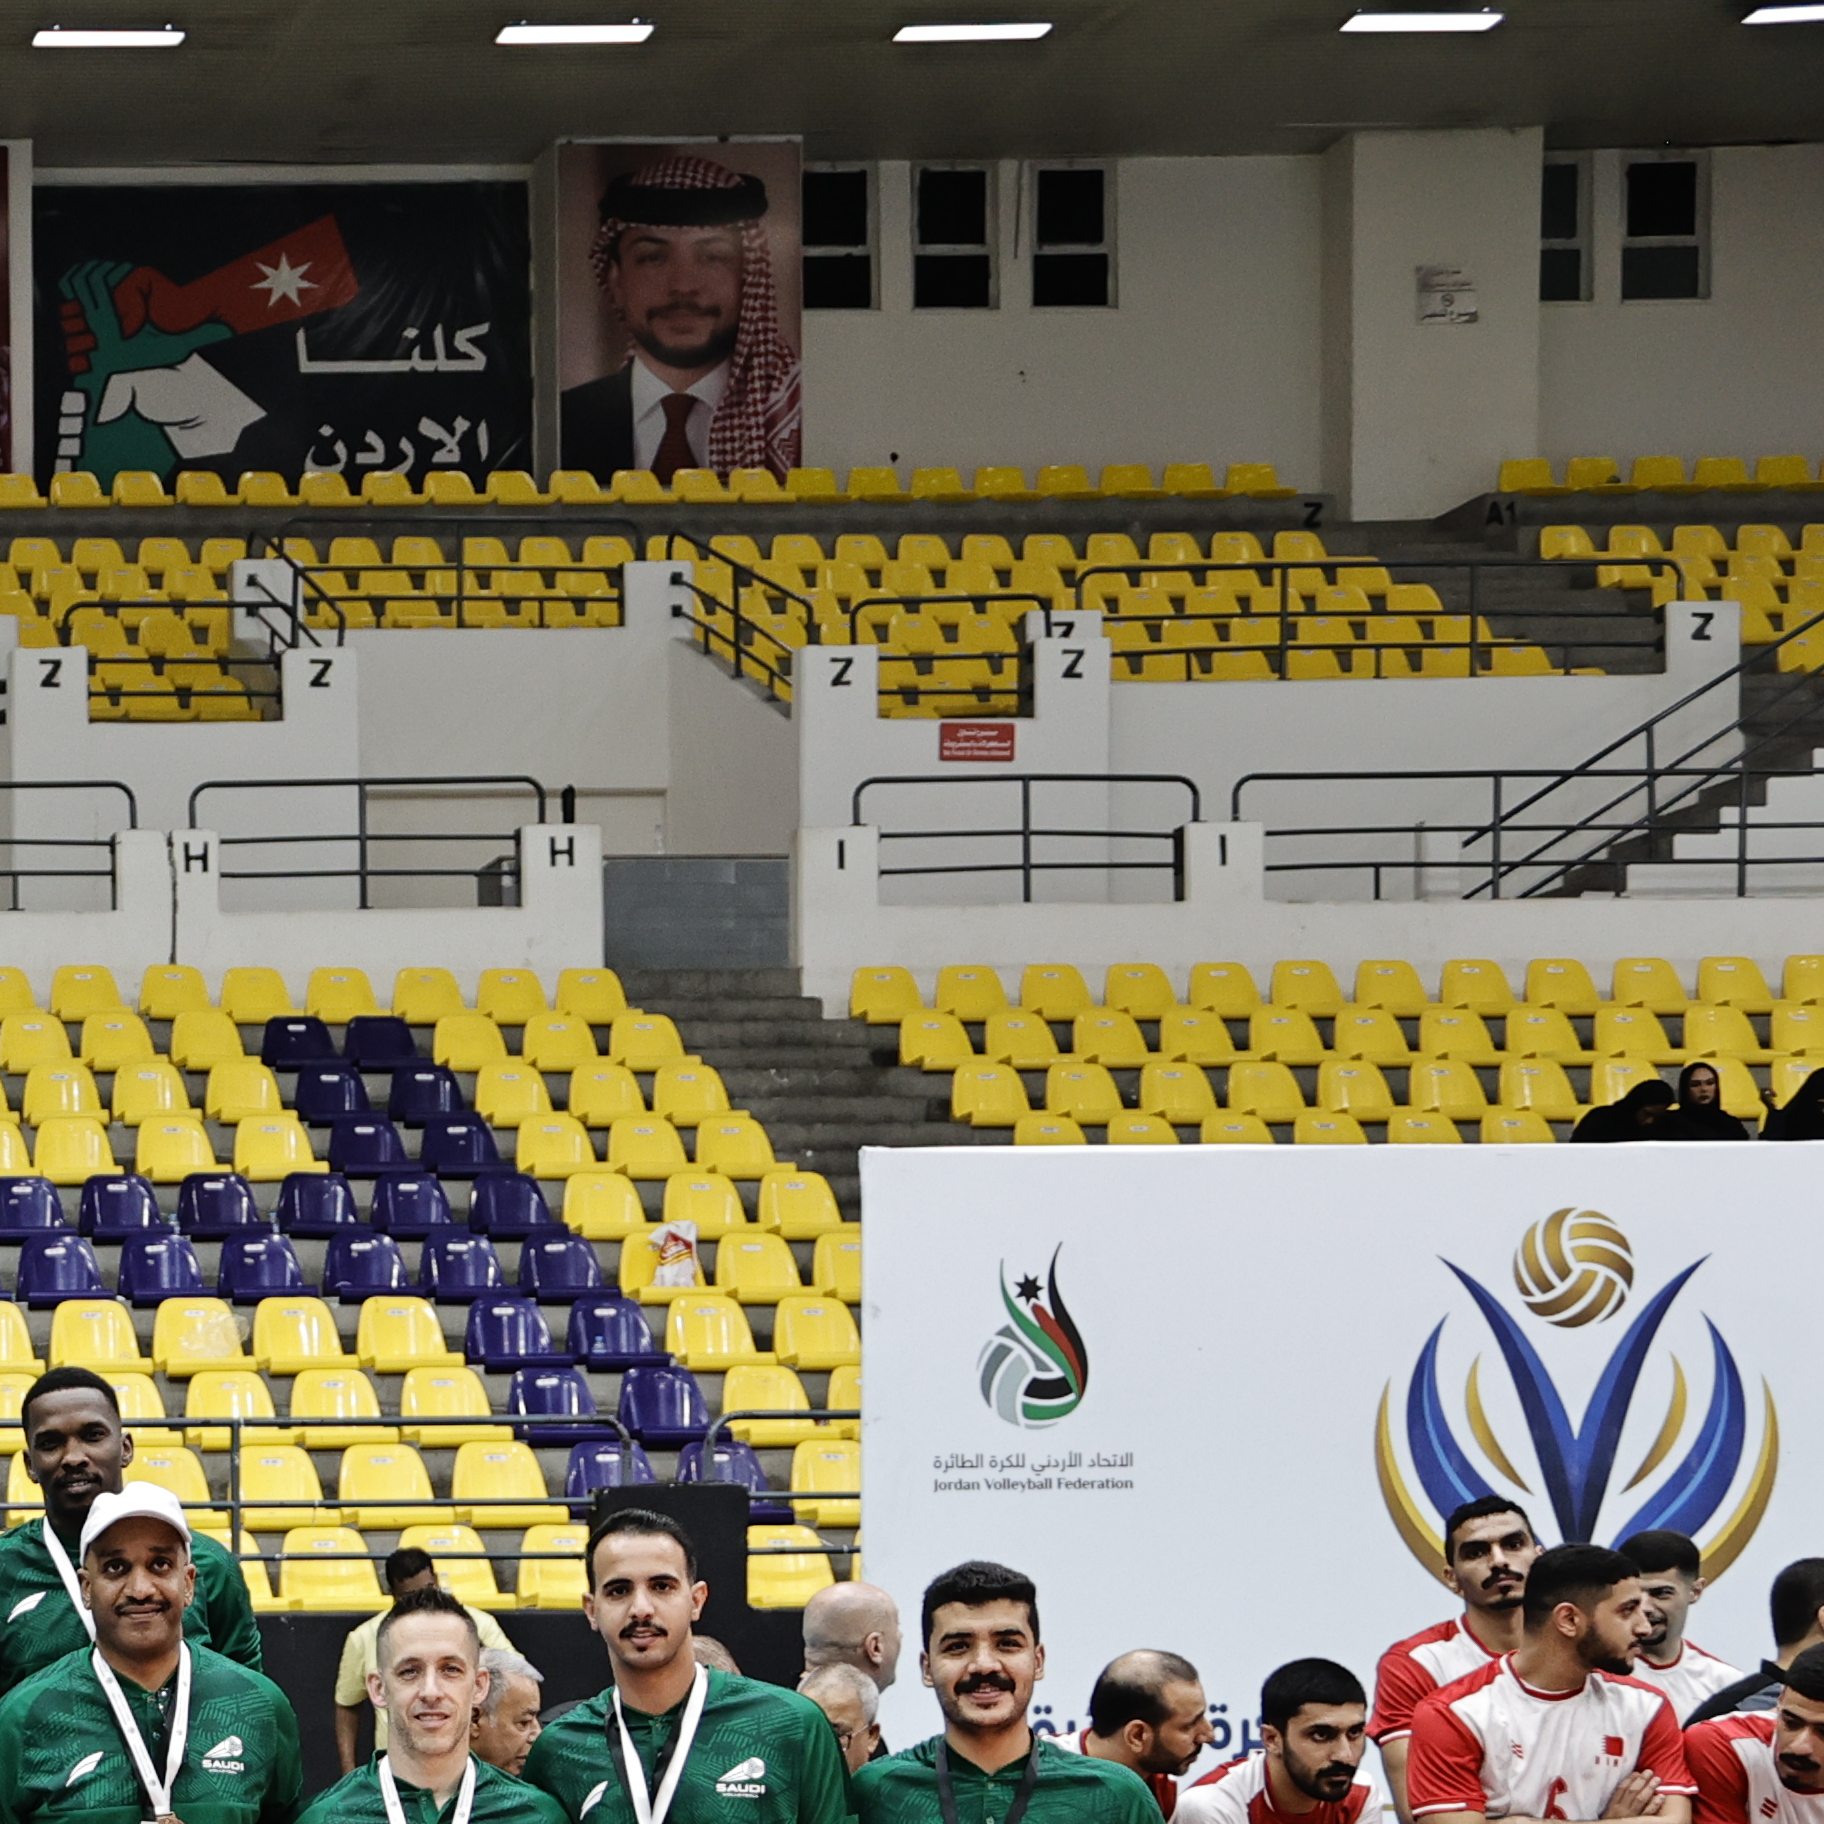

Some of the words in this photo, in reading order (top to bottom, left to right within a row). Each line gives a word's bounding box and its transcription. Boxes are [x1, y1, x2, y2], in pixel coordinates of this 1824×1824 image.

[296, 322, 490, 373] كلنا
[1303, 502, 1322, 528] Z
[1485, 500, 1517, 526] A1
[1691, 612, 1714, 641] Z
[39, 659, 62, 688] Z
[309, 658, 333, 688] Z
[829, 656, 853, 687] Z
[1061, 648, 1085, 678] Z
[183, 841, 208, 873] H
[550, 835, 574, 867] H
[933, 1453, 984, 1474] الطائرة
[989, 1453, 1026, 1474] للكرة
[1031, 1450, 1083, 1477] الأردني
[1087, 1452, 1134, 1469] الاتحاد
[933, 1478, 980, 1493] Jordan
[984, 1477, 1053, 1493] Volleyball
[1057, 1477, 1134, 1490] Federation
[202, 1759, 244, 1771] SAUDI
[715, 1783, 766, 1794] SAUDI
